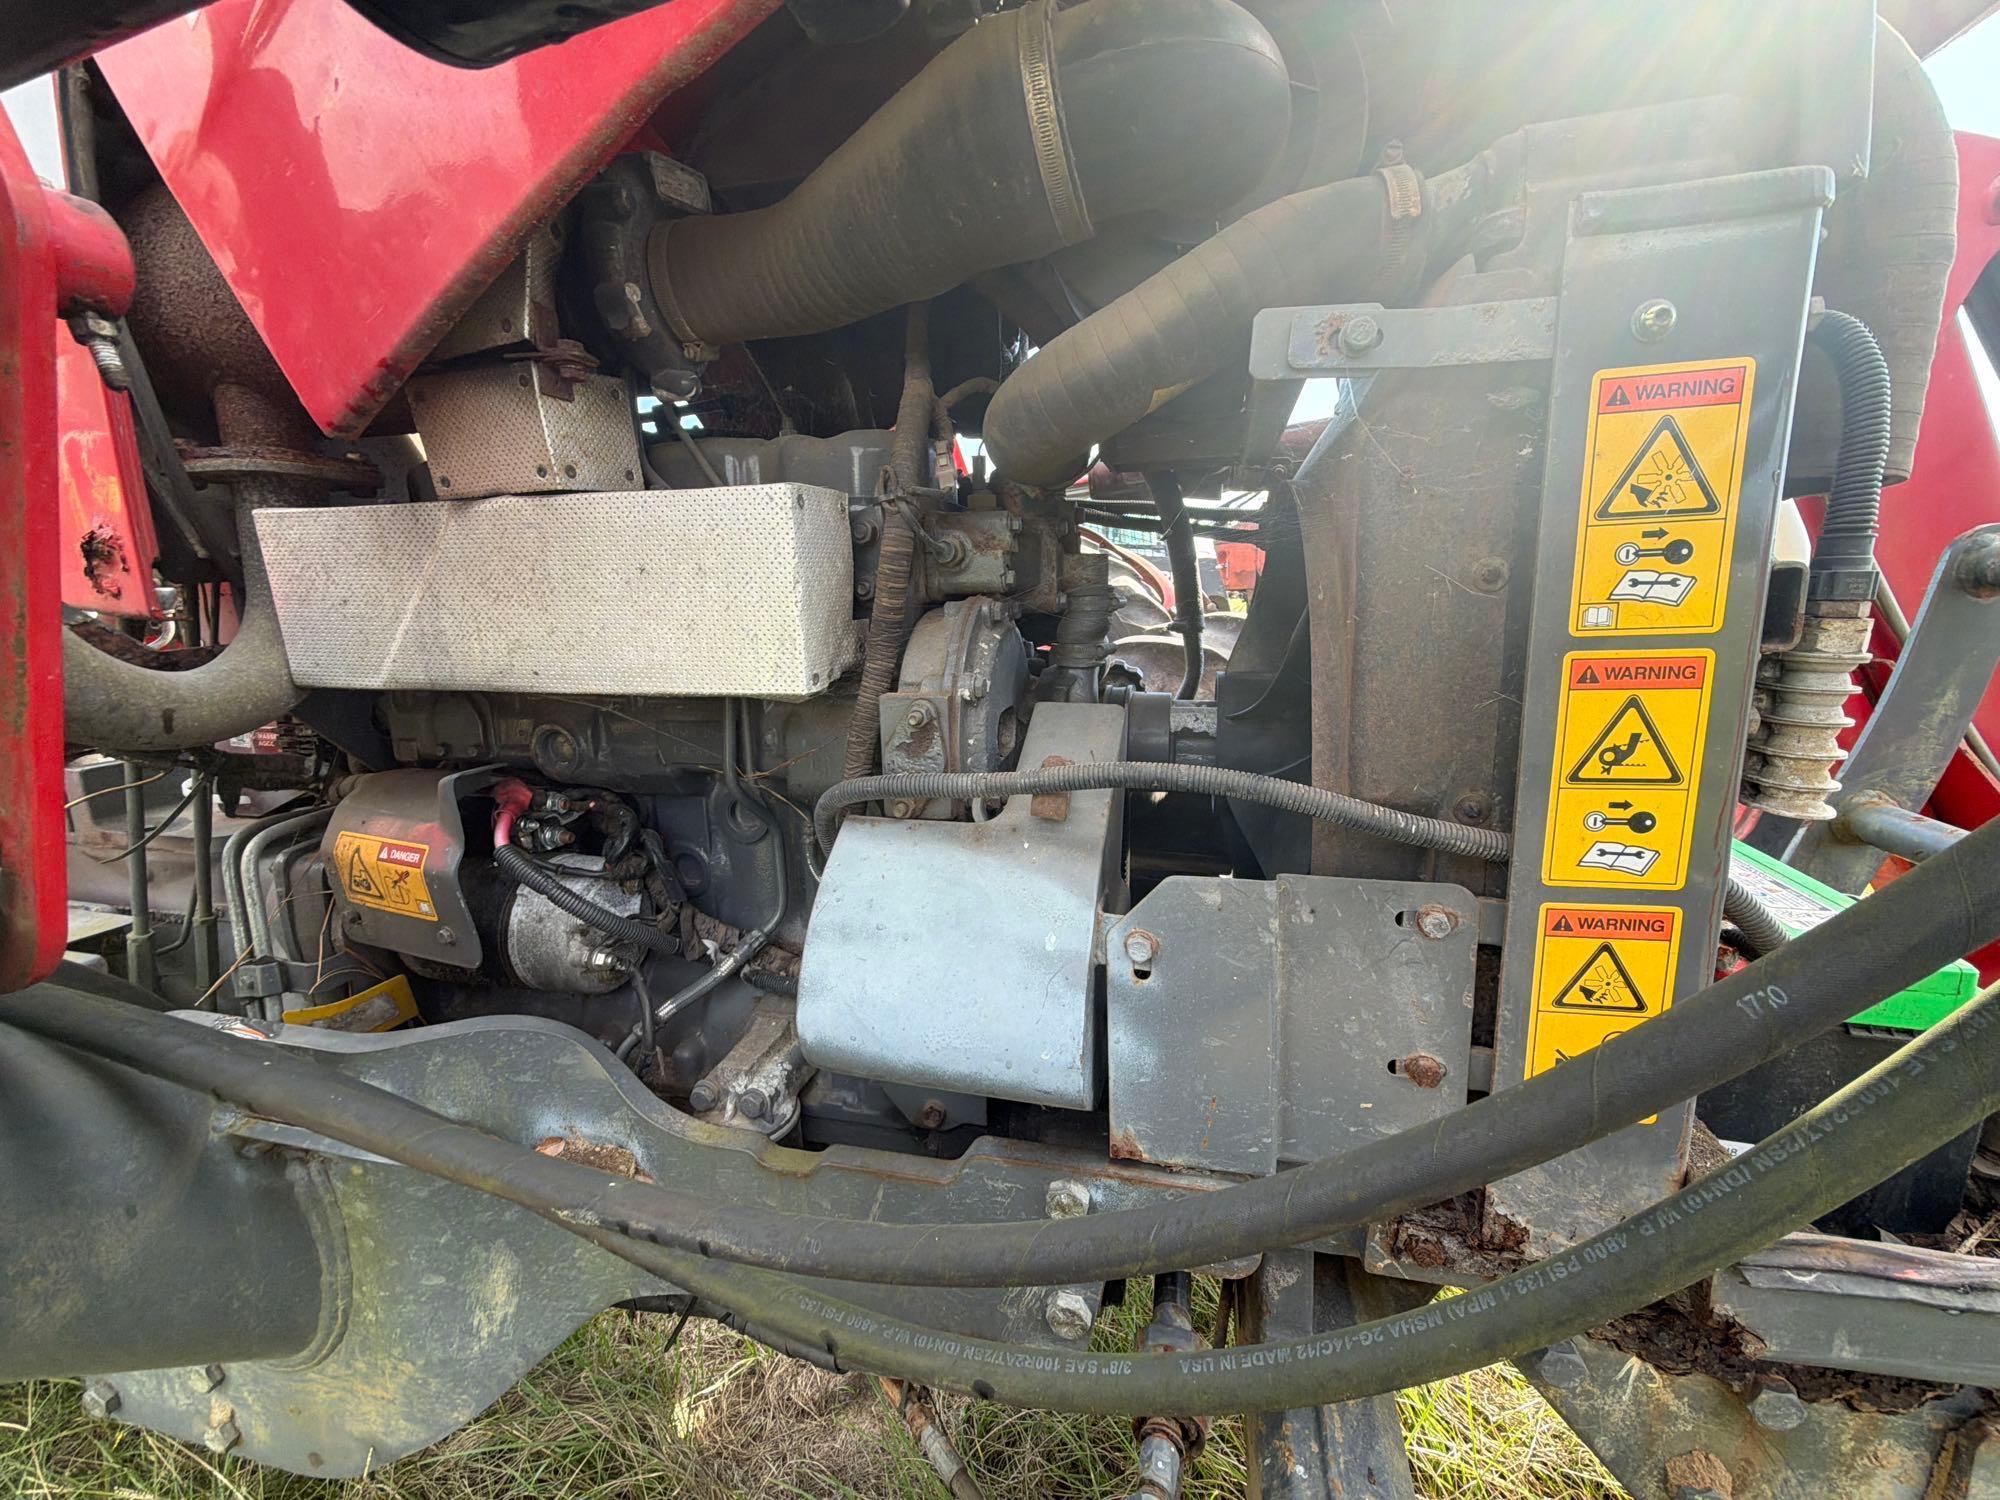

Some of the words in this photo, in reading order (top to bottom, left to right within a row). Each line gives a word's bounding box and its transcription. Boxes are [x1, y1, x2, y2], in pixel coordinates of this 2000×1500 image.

[1634, 377, 1736, 401] WARNING
[1603, 665, 1697, 682] WARNING
[390, 848, 421, 864] DANGER
[1577, 917, 1666, 933] WARNING
[1582, 1232, 1628, 1265] 4800
[1545, 1254, 1581, 1282] PSI
[1445, 1288, 1497, 1321] MPA)
[1387, 1309, 1444, 1339] MSHA
[912, 1332, 960, 1357] (DN10)
[1065, 1358, 1098, 1375] SAE
[1178, 1357, 1214, 1375] USA
[1219, 1353, 1237, 1371] IN
[1240, 1346, 1291, 1368] MADE
[1101, 1360, 1132, 1375] 3/8"
